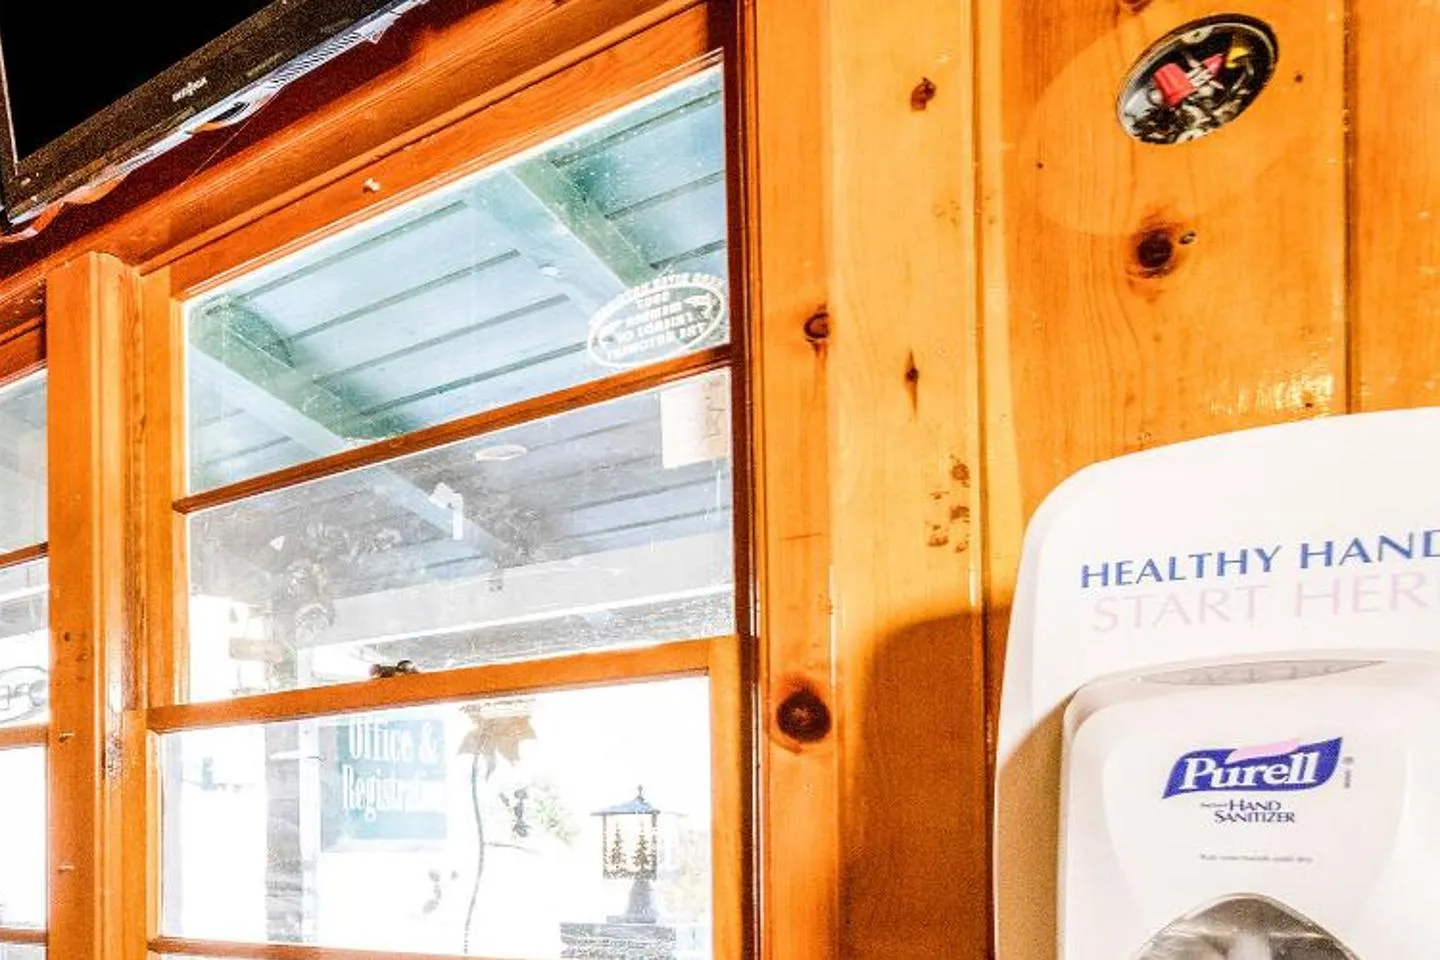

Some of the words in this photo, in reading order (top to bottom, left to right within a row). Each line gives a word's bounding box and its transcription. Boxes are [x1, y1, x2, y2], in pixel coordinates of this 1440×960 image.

[1081, 545, 1282, 588] HEALTHY
[1092, 584, 1269, 633] START
[1294, 570, 1440, 618] HER
[1179, 751, 1320, 790] Purell
[1215, 810, 1296, 823] SANITIZER
[1229, 799, 1281, 811] HAND
